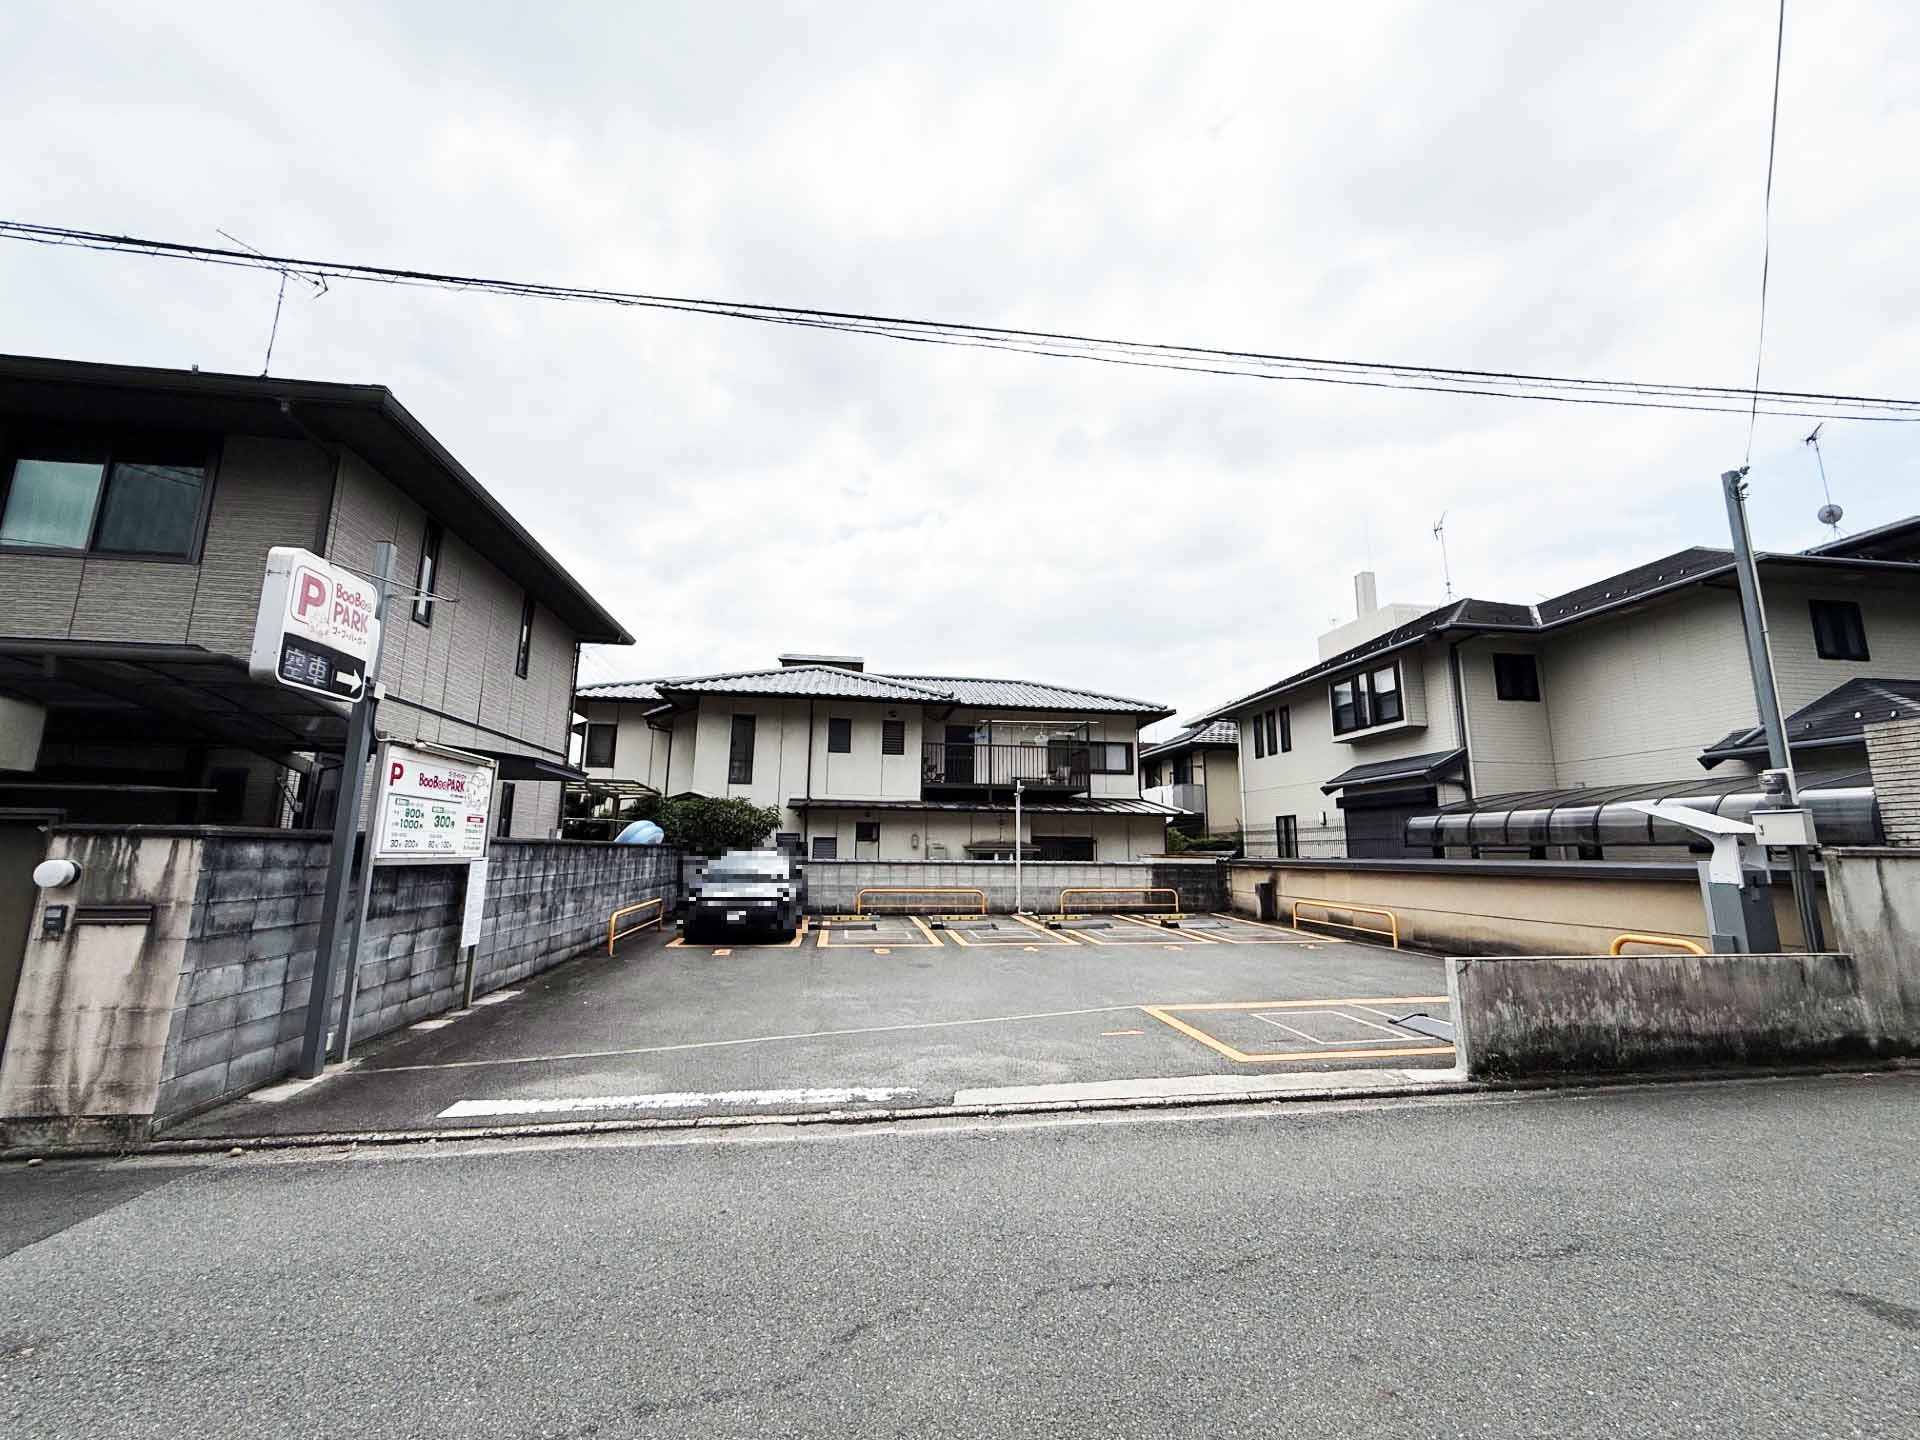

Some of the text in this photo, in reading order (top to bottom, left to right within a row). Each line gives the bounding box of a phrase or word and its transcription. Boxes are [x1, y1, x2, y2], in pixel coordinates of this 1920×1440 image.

[297, 573, 326, 616] P
[333, 601, 369, 633] PARK
[389, 762, 404, 786] P
